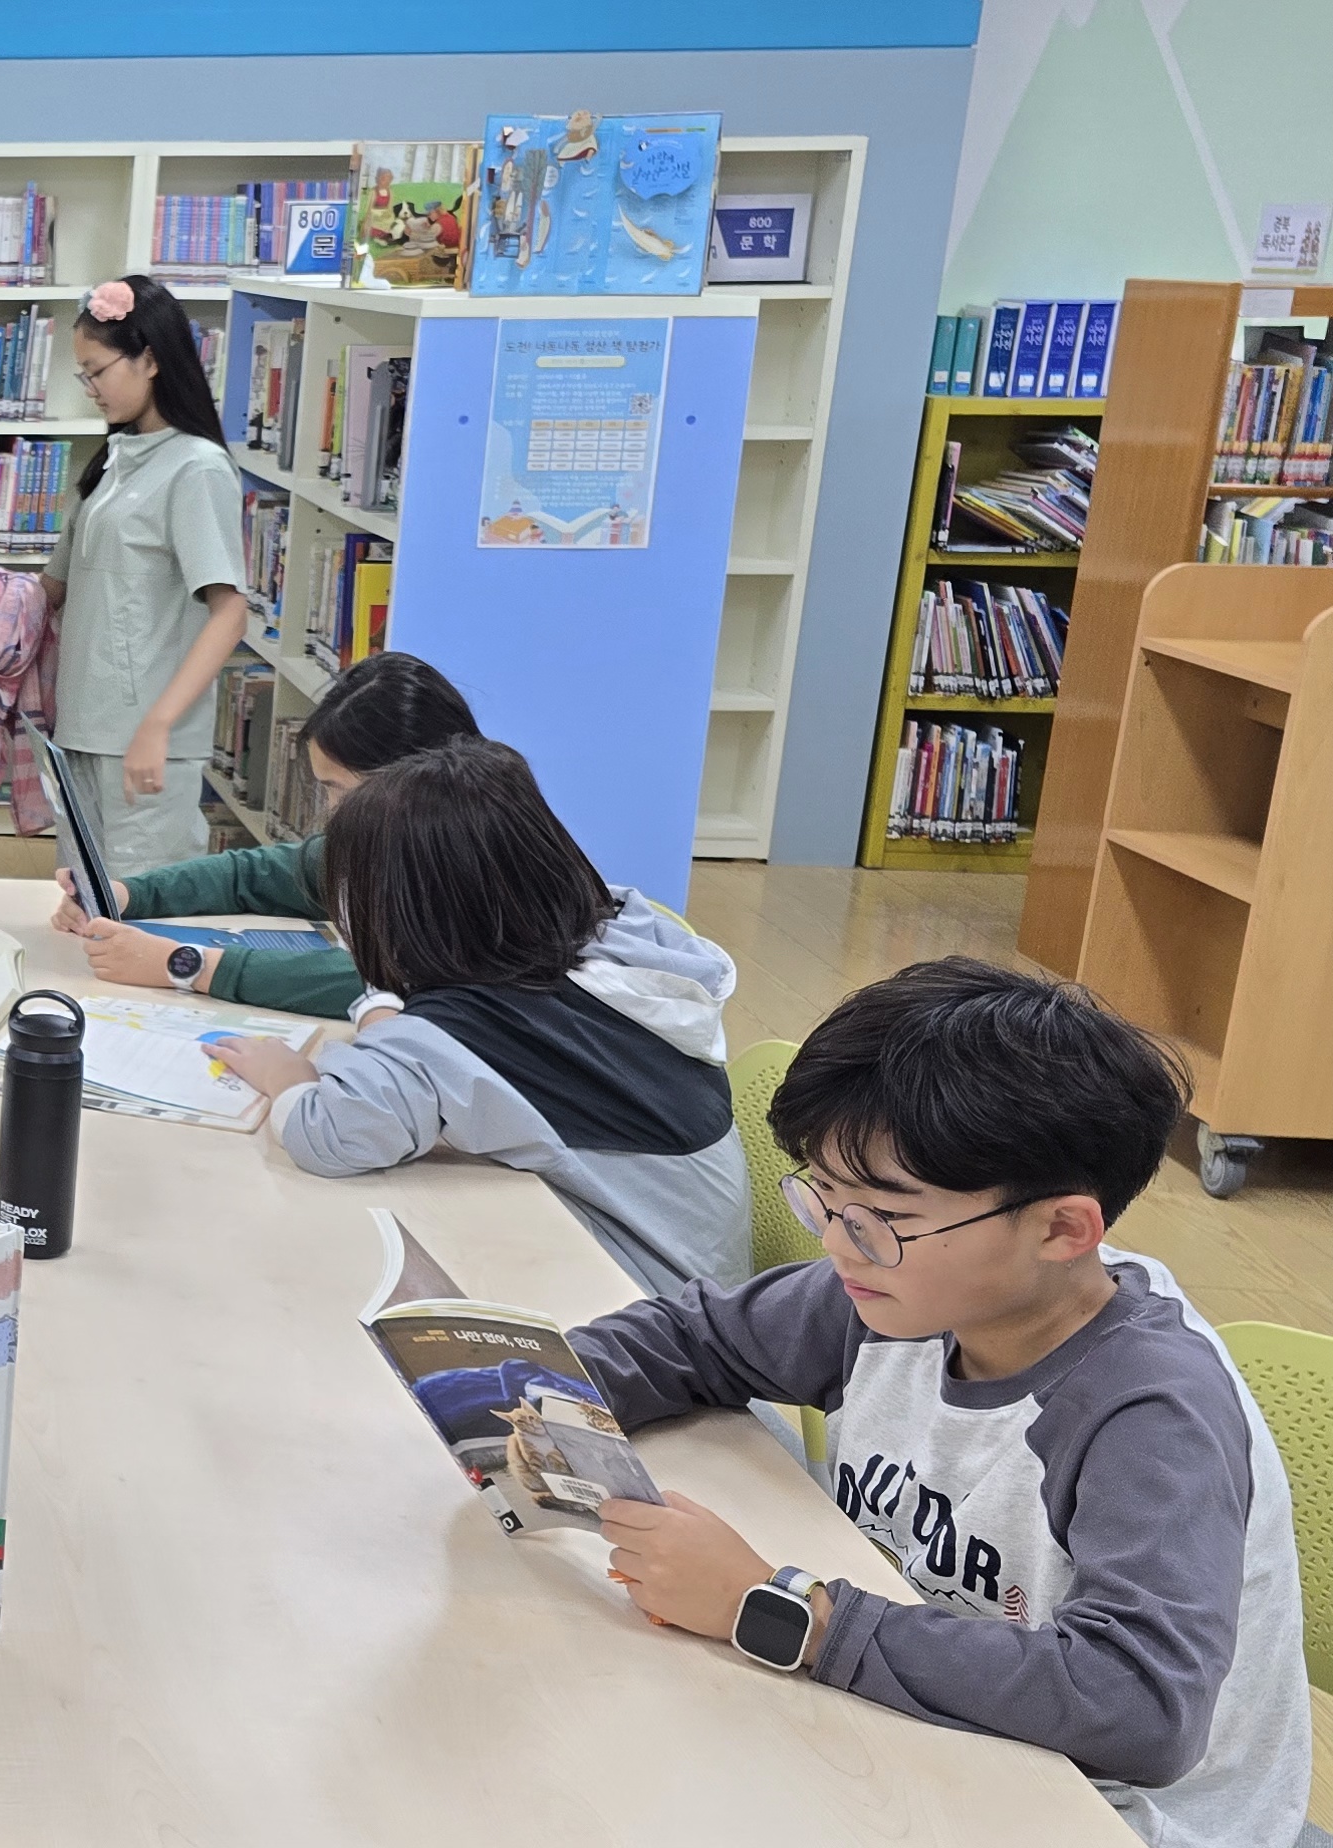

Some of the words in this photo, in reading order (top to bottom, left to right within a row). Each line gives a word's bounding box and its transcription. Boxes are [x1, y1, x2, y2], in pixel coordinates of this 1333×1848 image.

[298, 209, 337, 230] 800
[748, 216, 772, 229] 800
[0, 1200, 39, 1219] READY
